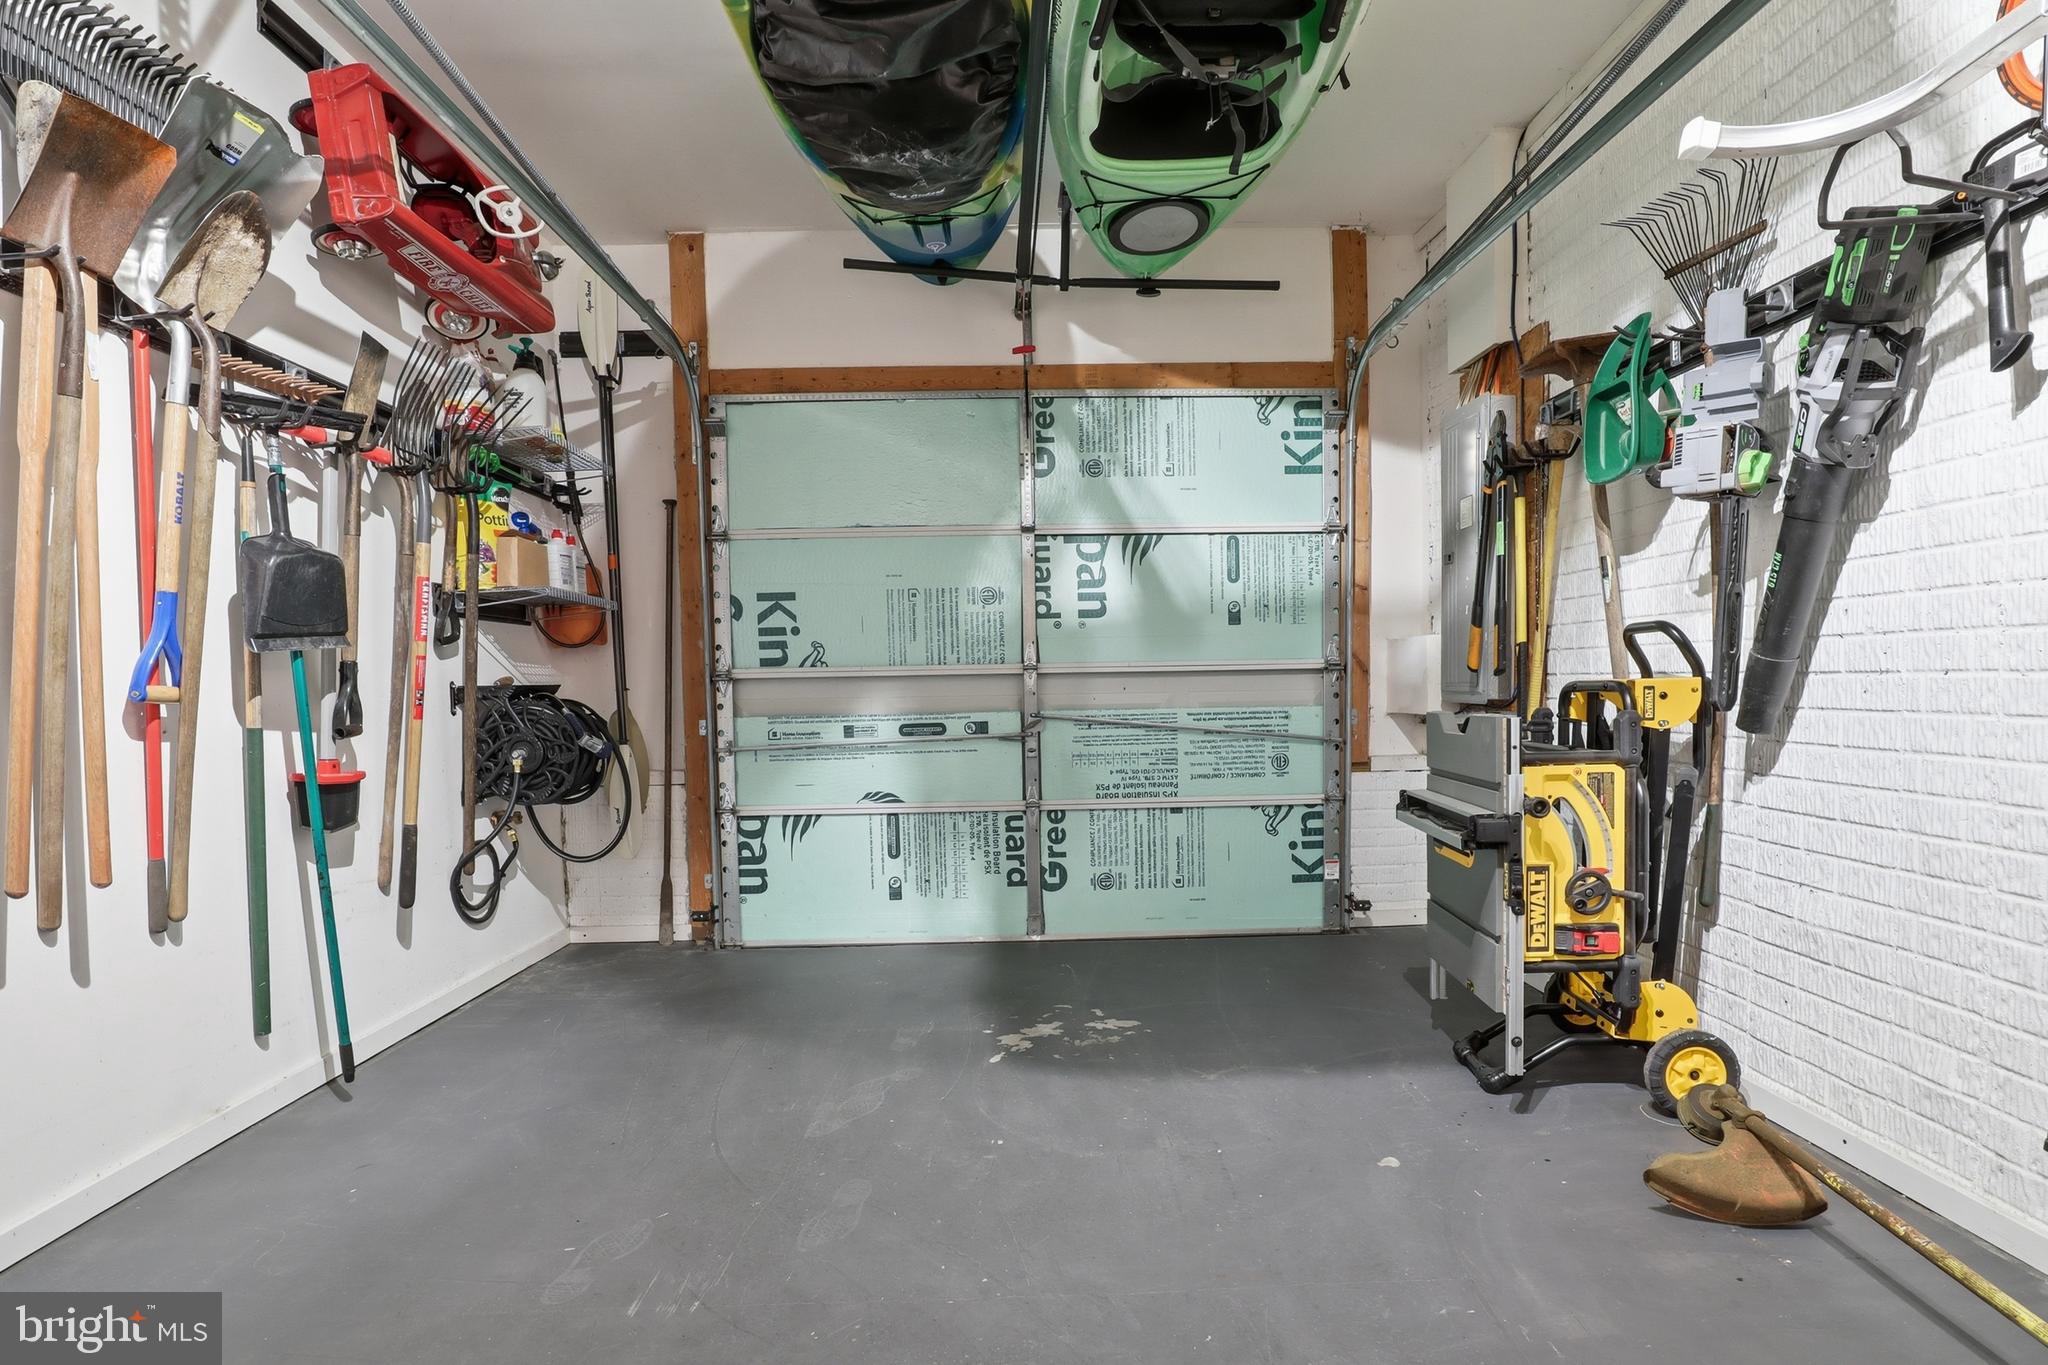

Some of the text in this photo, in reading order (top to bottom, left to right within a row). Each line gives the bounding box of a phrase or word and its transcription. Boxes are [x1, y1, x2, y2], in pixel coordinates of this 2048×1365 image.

[407, 249, 442, 274] FIRE
[1281, 400, 1323, 474] Kin
[1795, 408, 1807, 449] EGO
[174, 472, 184, 524] KOBALT
[756, 592, 800, 667] Kin
[1645, 688, 1653, 718] DEWALT
[1095, 783, 1110, 791] PSX
[983, 824, 991, 848] isolant
[984, 850, 991, 858] de
[993, 851, 1001, 875] Board
[1529, 870, 1546, 947] DEWALT
